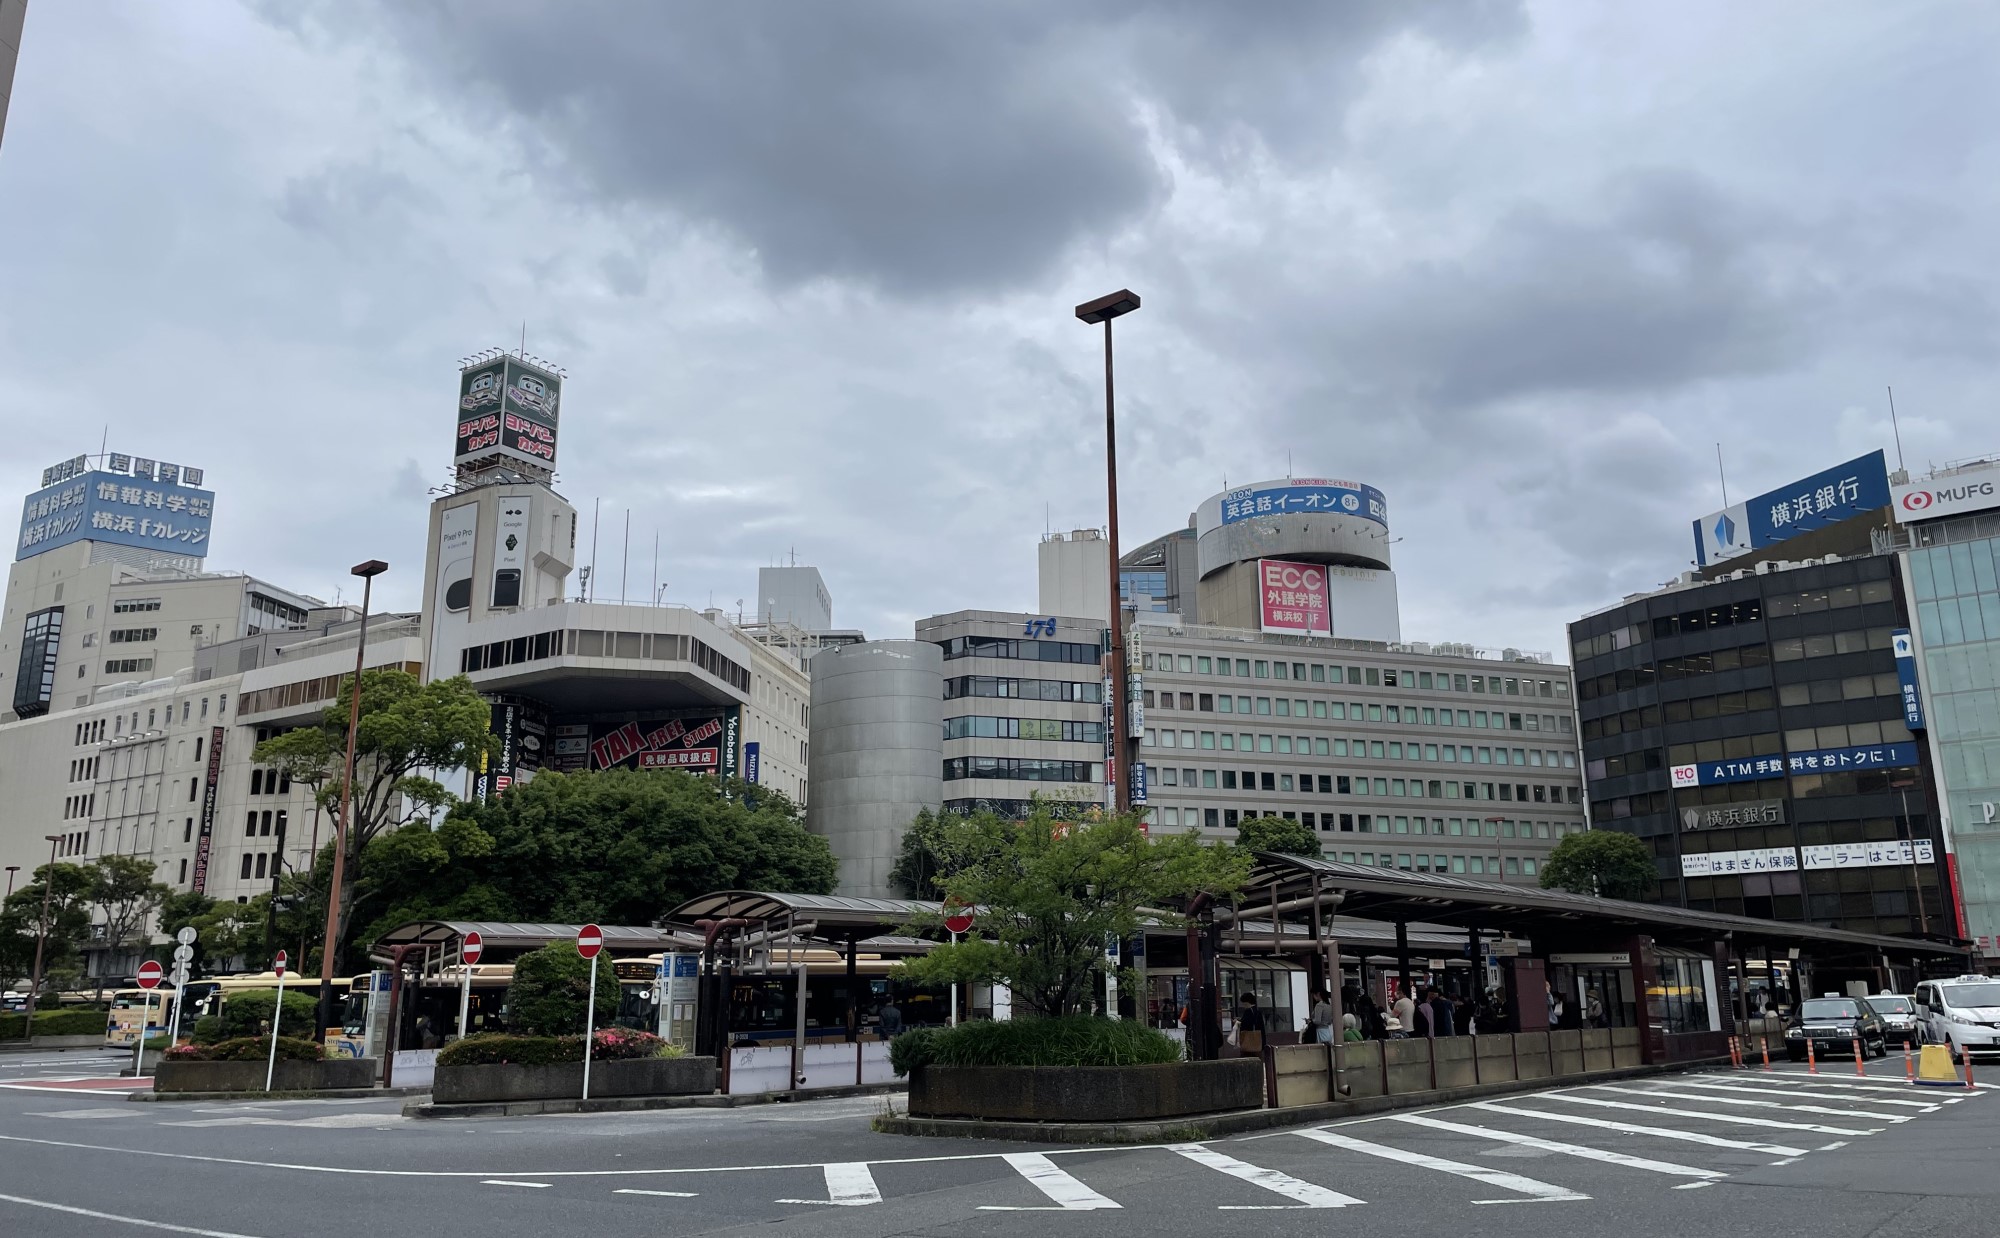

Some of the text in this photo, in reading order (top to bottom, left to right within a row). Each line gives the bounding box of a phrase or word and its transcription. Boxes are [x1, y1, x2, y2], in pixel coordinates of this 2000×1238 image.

[459, 415, 499, 438] ヨドバシ
[505, 414, 554, 442] ヨドバシ
[468, 431, 498, 451] カメラ
[518, 436, 553, 459] カメラ
[42, 455, 86, 487] 岩崎学園
[111, 454, 202, 485] 岩崎学園
[97, 481, 211, 518] 情報科学 専門 学校
[1227, 488, 1252, 500] AEON
[1770, 475, 1860, 528] 横浜銀行
[1936, 482, 1994, 504] MUFG
[27, 488, 72, 523] 情報科学
[1227, 493, 1357, 519] 英会話イーオン 8F
[443, 532, 457, 542] Pixel
[463, 529, 473, 537] Pro
[1265, 566, 1321, 590] ECC
[1267, 590, 1322, 608] 外語学院
[1024, 618, 1056, 638] 178
[1272, 610, 1303, 623] 横浜校
[1133, 640, 1141, 664] 富士学院
[1903, 684, 1918, 723] 横浜銀行
[591, 721, 649, 770] TAX
[646, 719, 686, 751] FREE
[682, 718, 722, 748] STORE
[726, 716, 737, 768] Yodobashi
[645, 752, 711, 765] 免税品取扱店
[1705, 804, 1779, 825] 横浜銀行
[1711, 848, 1932, 871] はまぎん保険 パーラーはこちら
